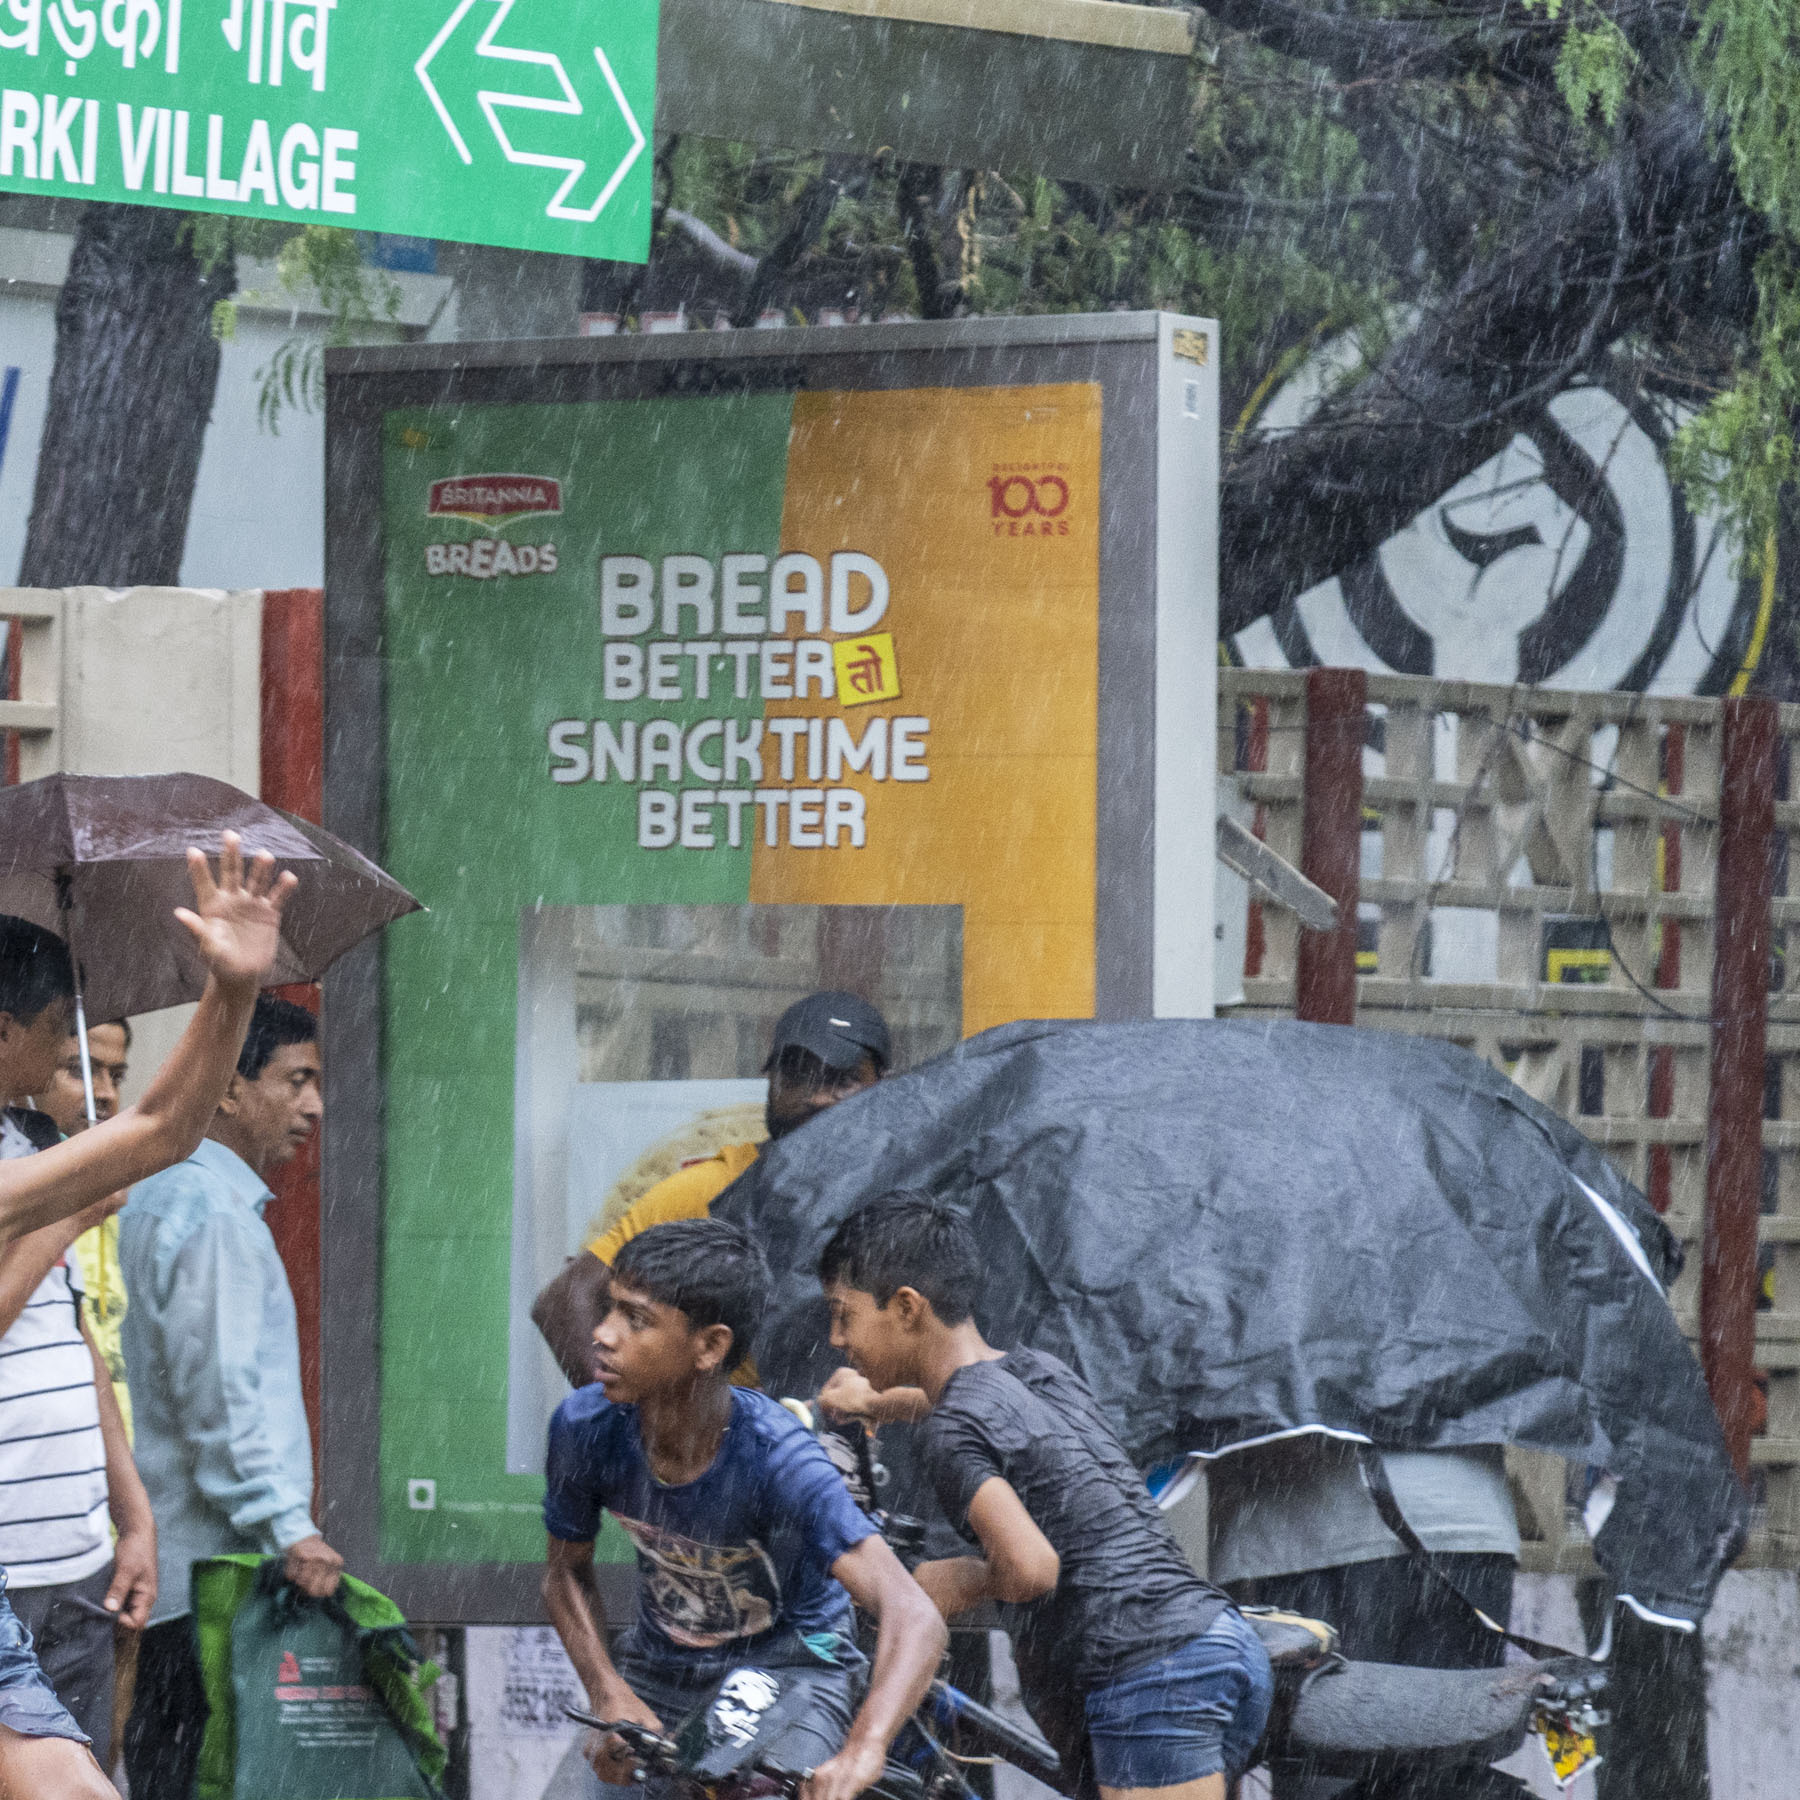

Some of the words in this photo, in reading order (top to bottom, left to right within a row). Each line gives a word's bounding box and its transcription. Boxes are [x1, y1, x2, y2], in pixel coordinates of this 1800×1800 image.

[117, 102, 358, 214] VILLAGE
[442, 486, 546, 505] BRITANNIA
[986, 475, 1069, 518] 100
[426, 539, 557, 577] BREADS
[992, 520, 1069, 536] YEARS
[601, 552, 890, 636] BREAD
[604, 640, 835, 700] BETTER
[846, 645, 883, 693] तो
[548, 717, 931, 783] SNACKTIME
[638, 788, 865, 848] BETTER
